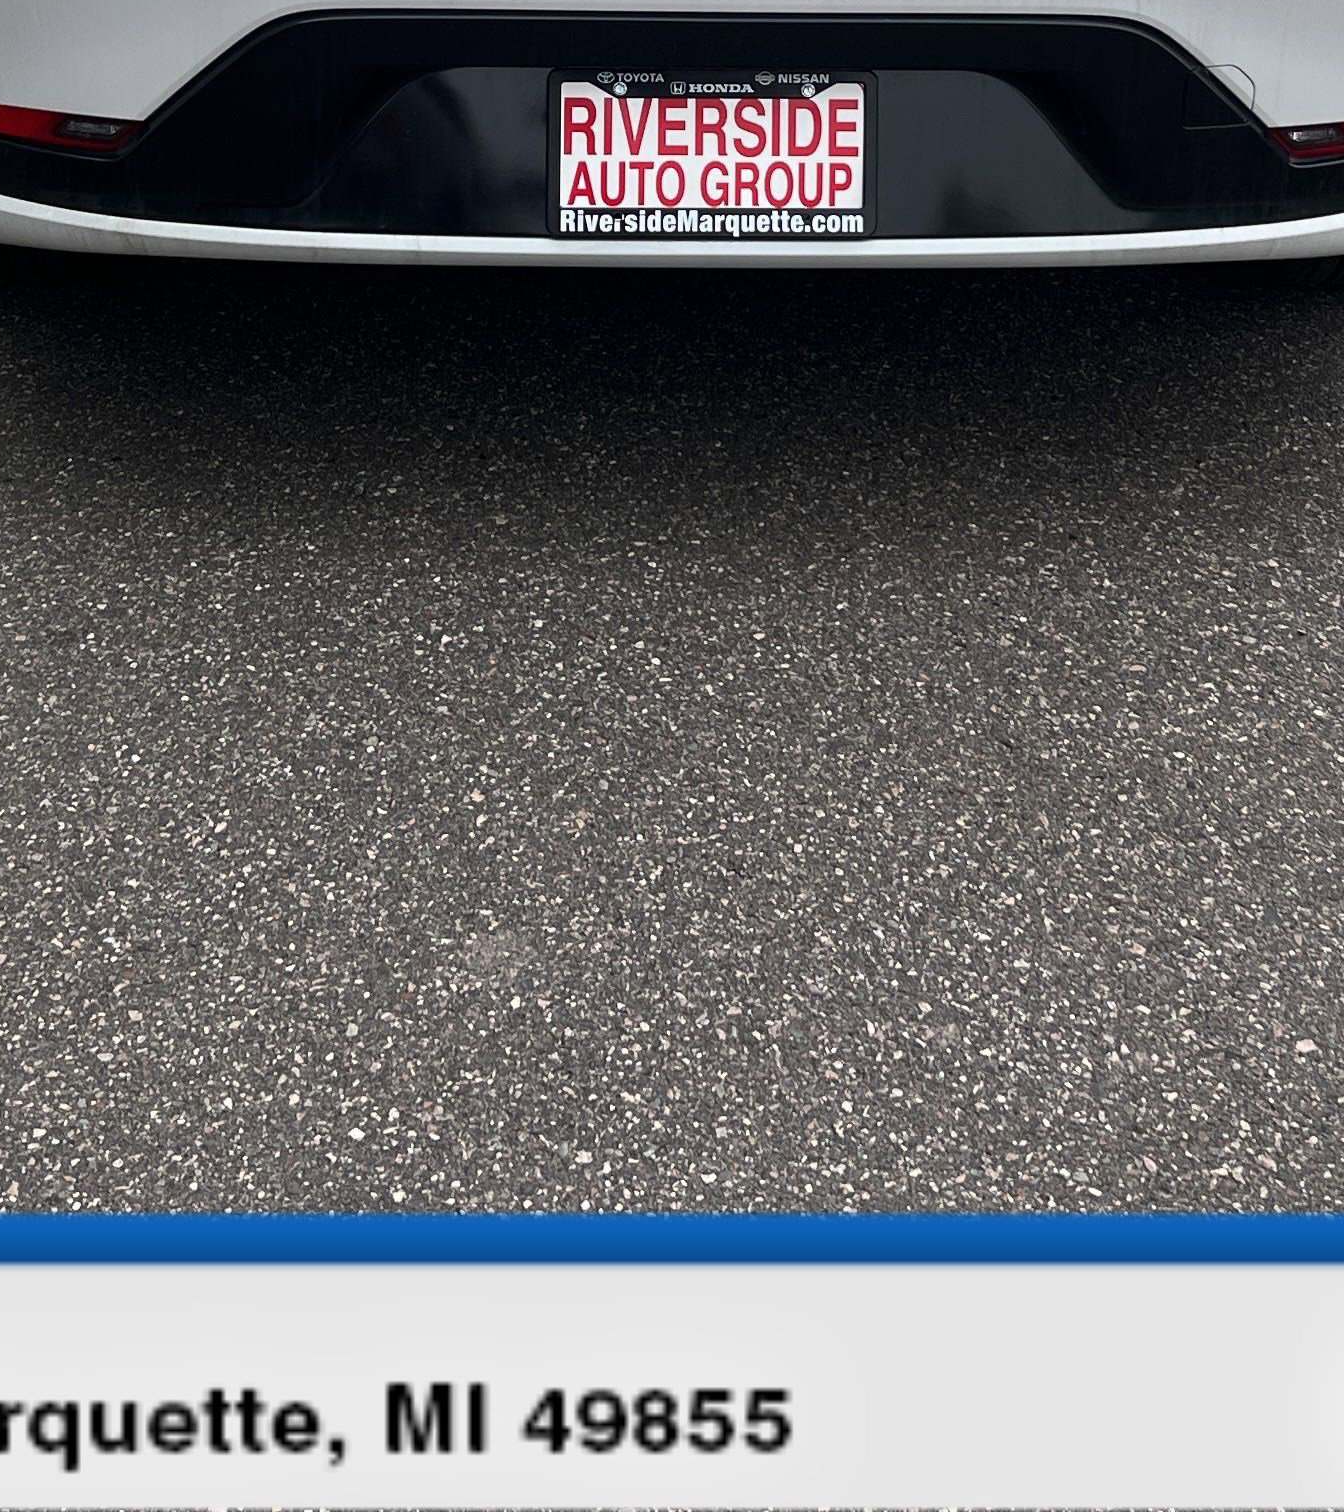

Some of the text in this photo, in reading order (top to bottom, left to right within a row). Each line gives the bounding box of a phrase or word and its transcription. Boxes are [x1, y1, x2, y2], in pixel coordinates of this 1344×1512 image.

[617, 73, 665, 84] TOYOTA
[777, 73, 830, 84] NISSAN
[688, 83, 755, 94] HONDA
[563, 96, 860, 157] RIVERSIDE
[567, 160, 853, 208] AUTO GROUP
[560, 209, 864, 237] RiversideMarquette.com
